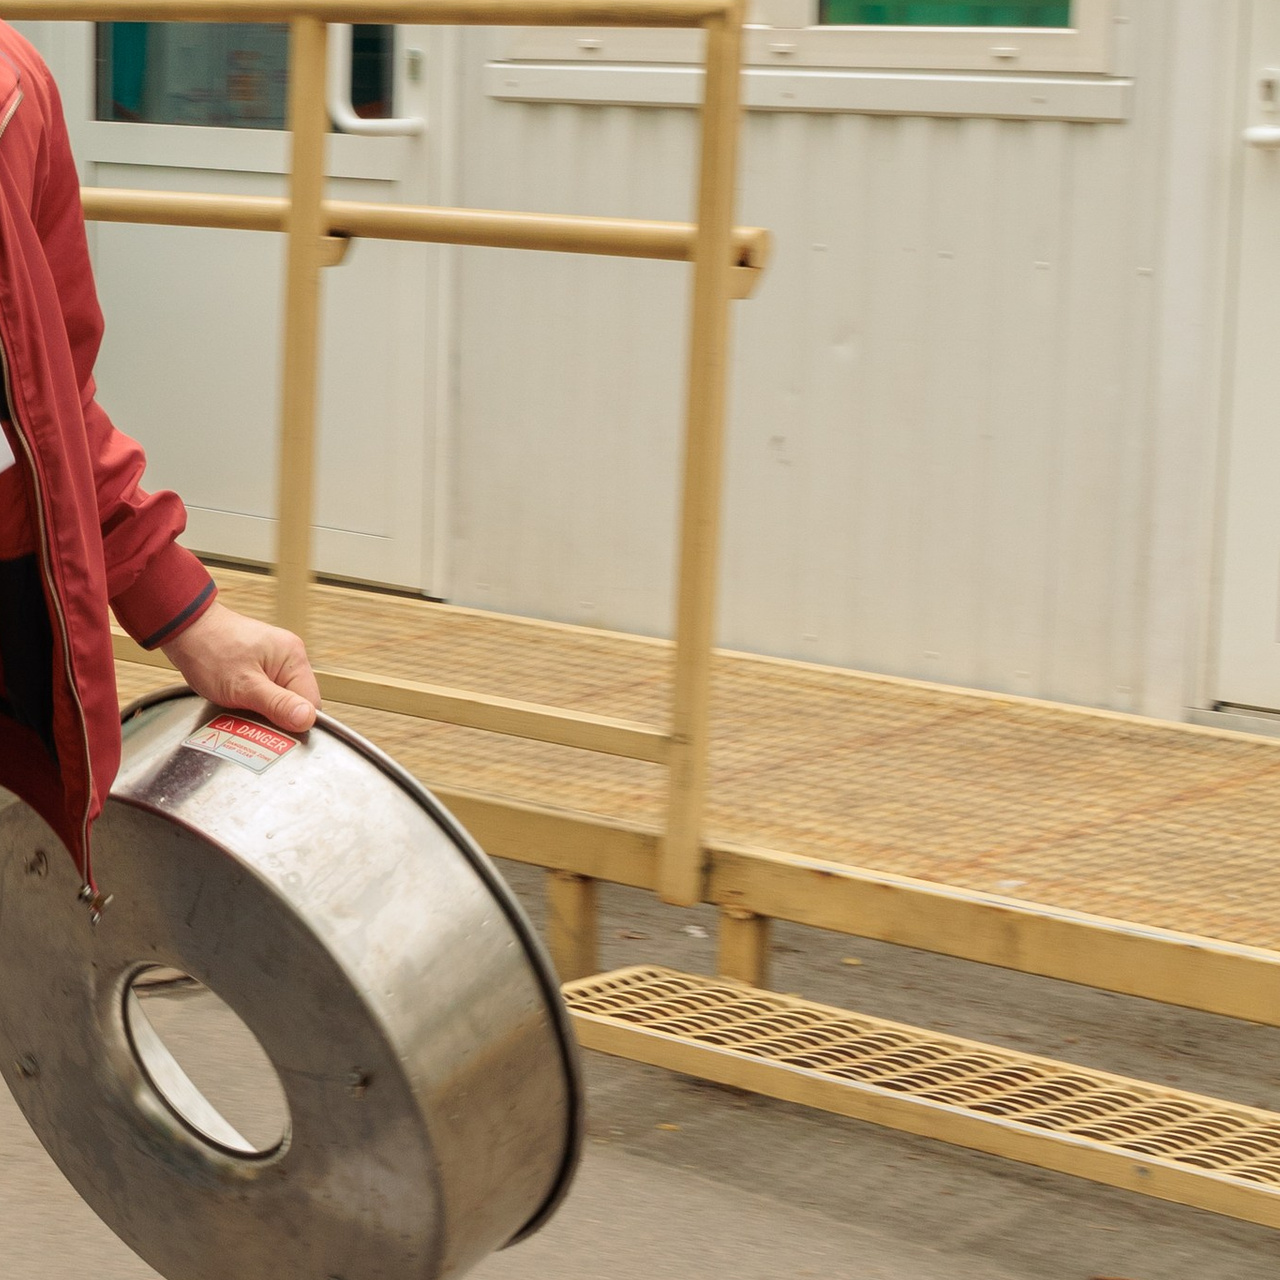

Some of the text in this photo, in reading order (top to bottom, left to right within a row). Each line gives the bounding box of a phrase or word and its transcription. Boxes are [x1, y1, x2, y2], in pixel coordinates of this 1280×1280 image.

[236, 724, 288, 751] DANGER
[226, 740, 257, 755] DANGEROUS
[236, 747, 254, 759] CLEAR
